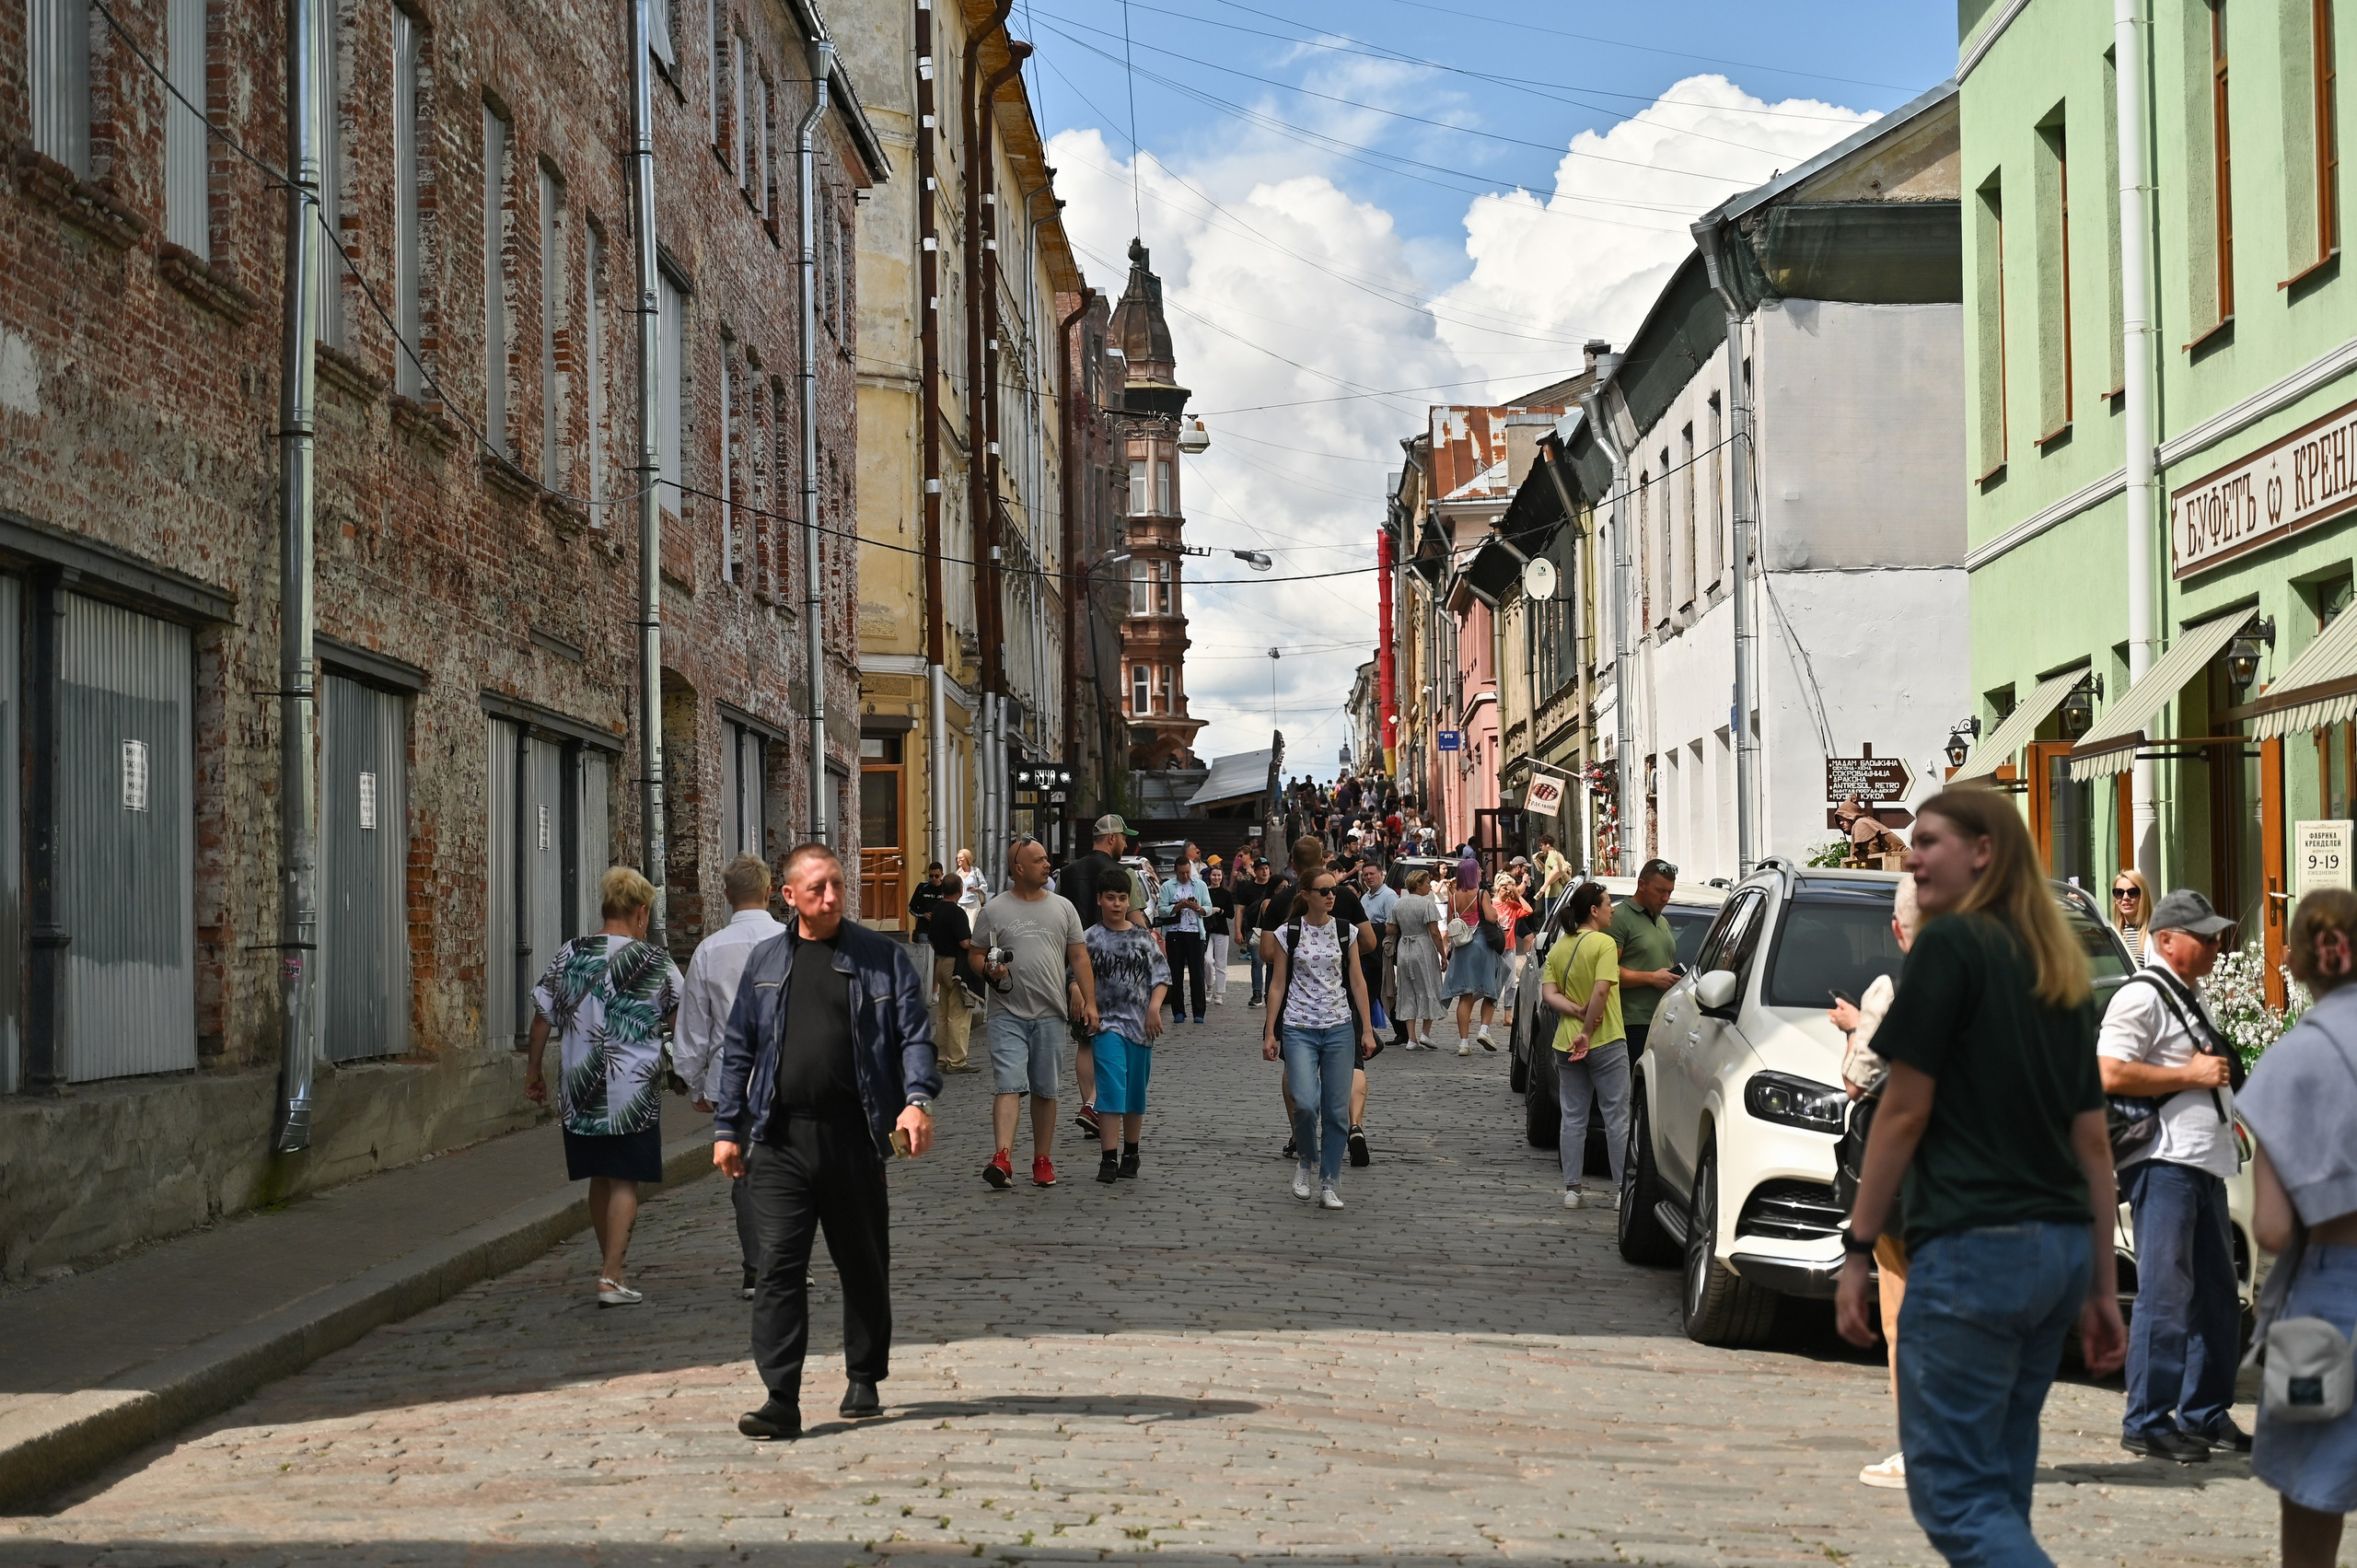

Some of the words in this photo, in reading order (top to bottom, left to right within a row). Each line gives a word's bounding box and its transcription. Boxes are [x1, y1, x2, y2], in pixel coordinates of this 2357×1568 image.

[2187, 472, 2257, 558] БУФЕТЪ
[1034, 769, 1056, 785] БУЧА
[2305, 839, 2341, 847] КРЕНДЕЛЕЙ
